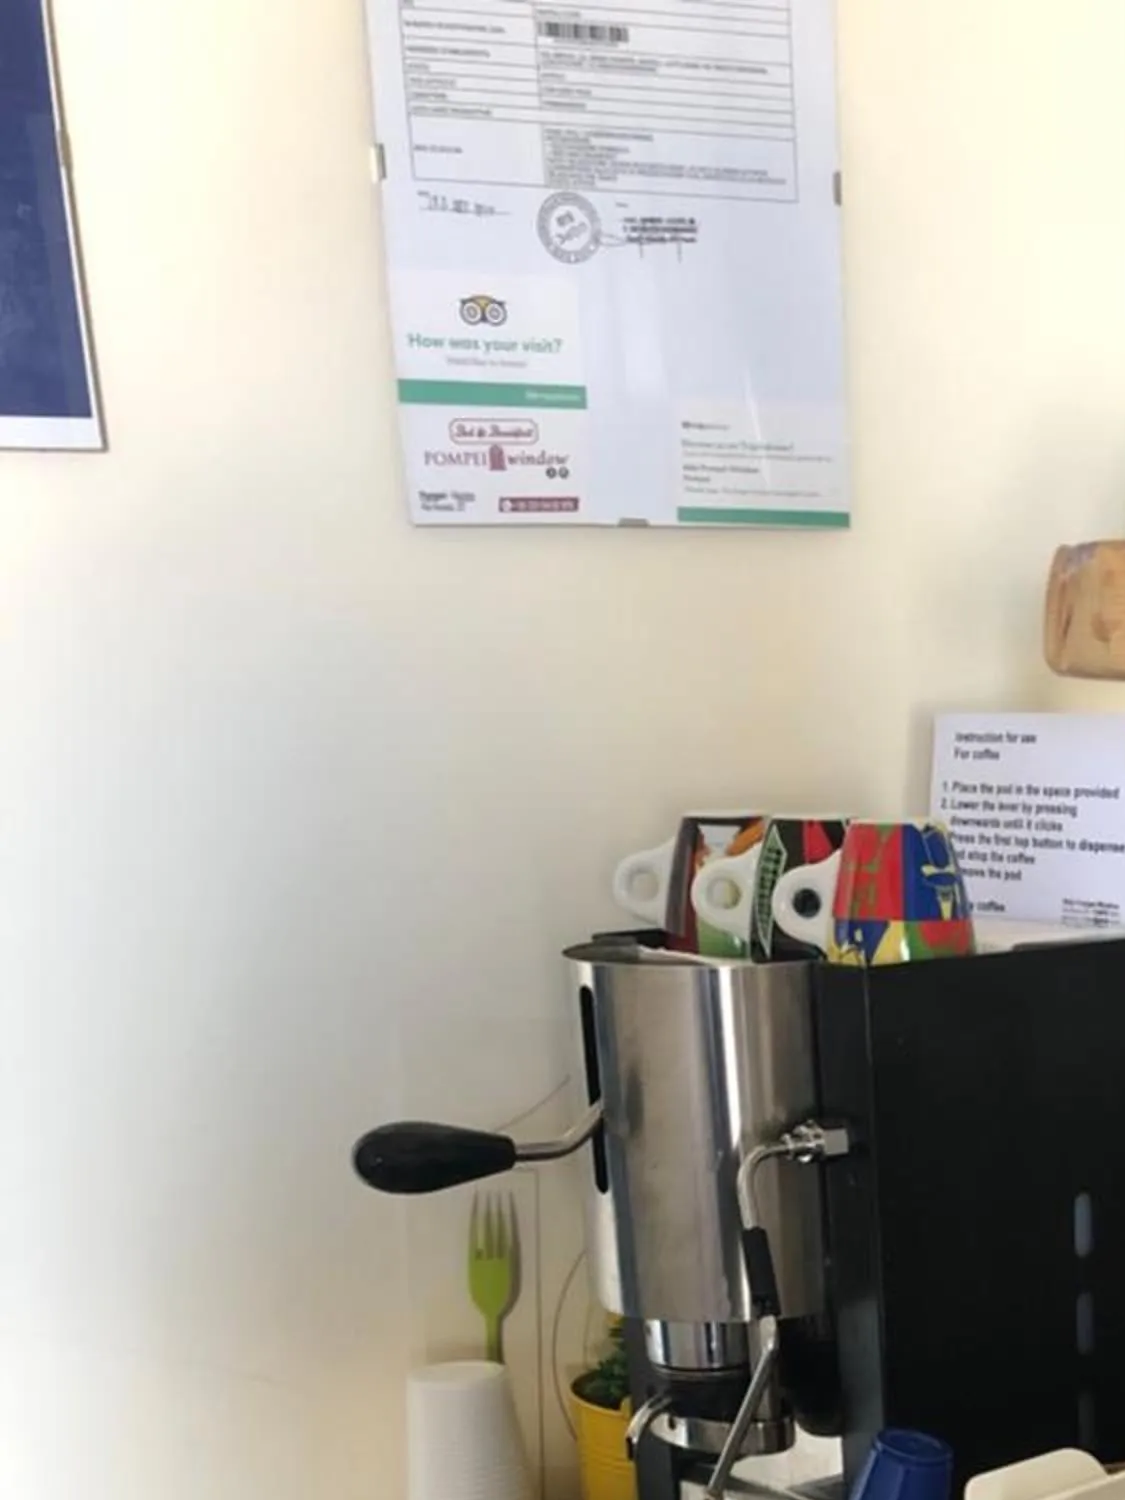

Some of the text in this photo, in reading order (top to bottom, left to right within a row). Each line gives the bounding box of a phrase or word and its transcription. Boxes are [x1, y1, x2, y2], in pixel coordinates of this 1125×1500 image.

[406, 333, 564, 354] How was your visit?
[423, 449, 571, 467] POMPEI window
[954, 731, 1037, 744] Instruction for use
[953, 747, 1000, 761] For coffee
[951, 781, 977, 794] Place
[979, 783, 995, 795] the
[995, 783, 1013, 797] pod
[1014, 785, 1024, 796] in
[1025, 783, 1041, 797] the
[1042, 786, 1071, 800] space
[1073, 786, 1120, 800] provided
[949, 798, 980, 811] Lower
[981, 800, 996, 812] the
[997, 800, 1019, 812] lever
[1021, 801, 1033, 816] by
[1034, 802, 1077, 819] pressing
[950, 815, 1001, 829] downwards
[1002, 818, 1025, 830] until
[977, 833, 992, 845] the
[993, 832, 1012, 846] first
[1013, 835, 1030, 849] top
[1031, 836, 1063, 849] button
[1065, 838, 1076, 851] to
[1078, 839, 1125, 855] dispense
[966, 850, 988, 863] stop
[989, 850, 1004, 863] the
[1005, 851, 1036, 865] coffee
[987, 867, 1002, 880] the
[1003, 868, 1023, 882] pod
[976, 900, 1006, 912] coffee
